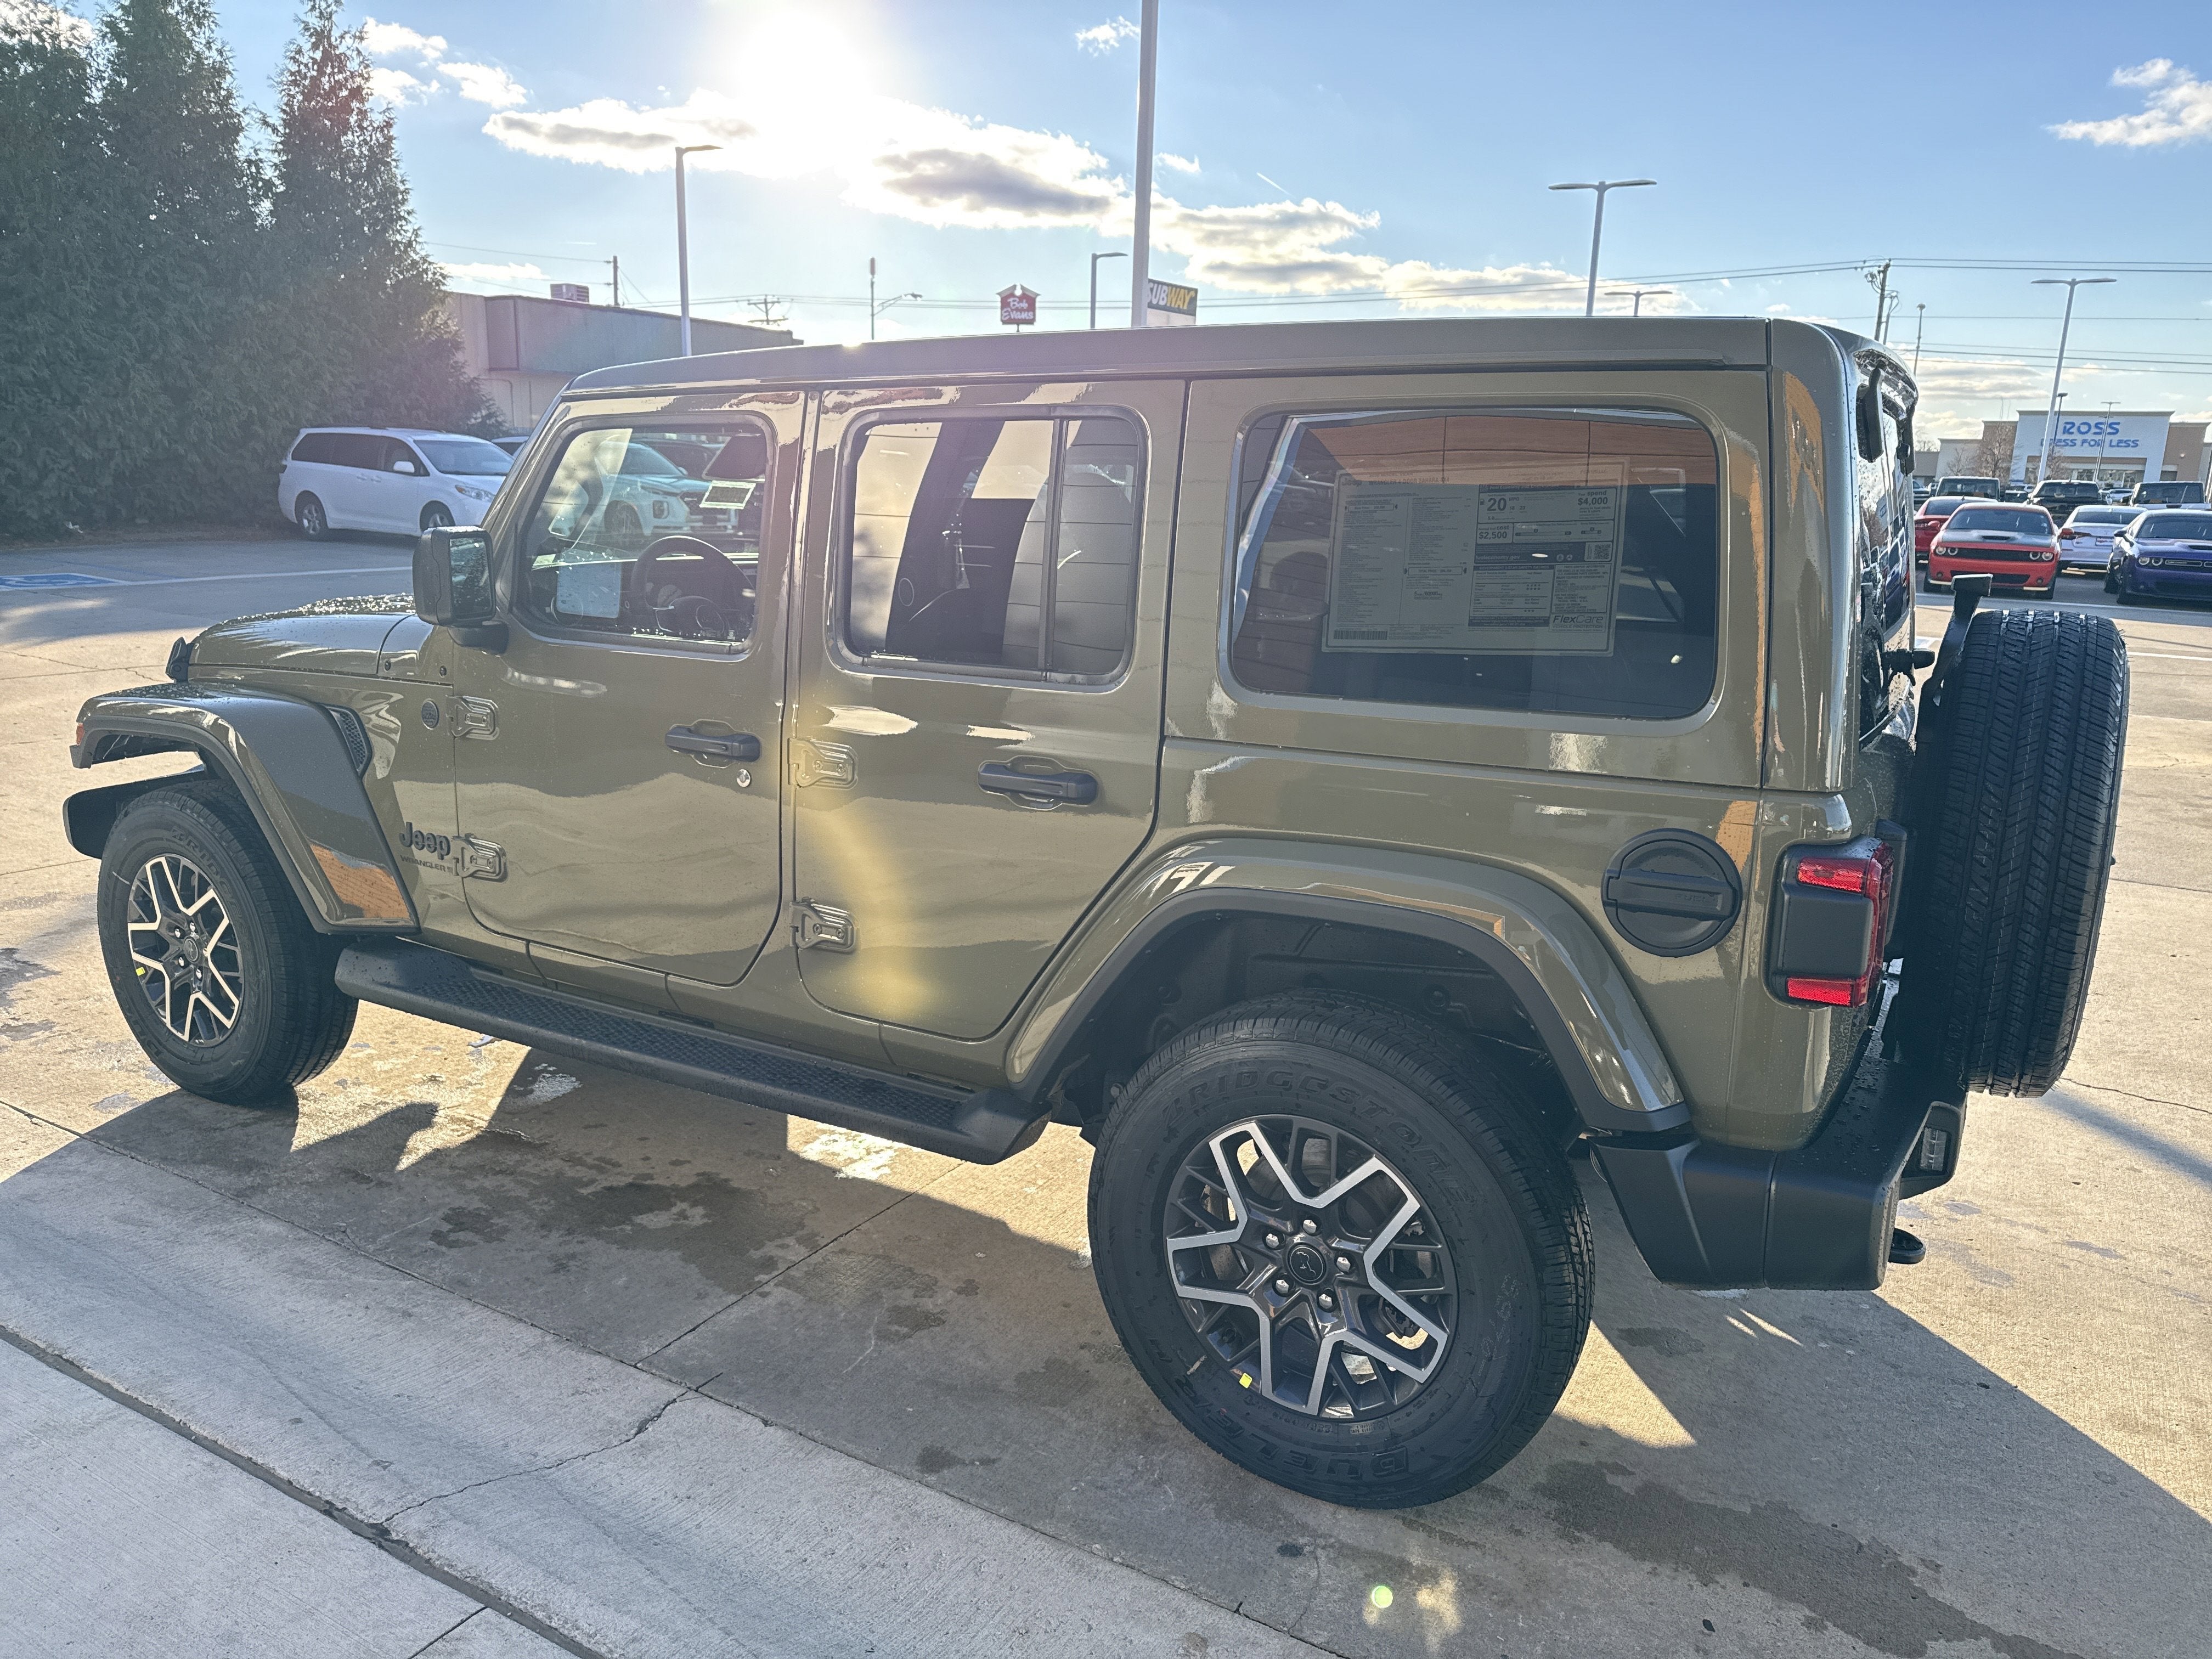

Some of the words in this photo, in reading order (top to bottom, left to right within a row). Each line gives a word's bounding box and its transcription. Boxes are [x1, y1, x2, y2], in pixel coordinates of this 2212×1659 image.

[1147, 282, 1195, 309] SUBWAY
[1007, 297, 1028, 311] Bob
[1001, 307, 1034, 321] Evans
[2062, 421, 2121, 435] ROSS
[2109, 439, 2140, 448] LESS
[1487, 498, 1507, 511] 20
[1578, 497, 1608, 506] $4,000
[1479, 532, 1507, 540] $2,500
[1553, 615, 1604, 623] FlexCare
[399, 821, 450, 861] Jeep
[400, 855, 446, 872] WRANGLER
[1160, 1067, 1476, 1203] BRIDGESTONE
[1174, 1373, 1409, 1480] DUELER
